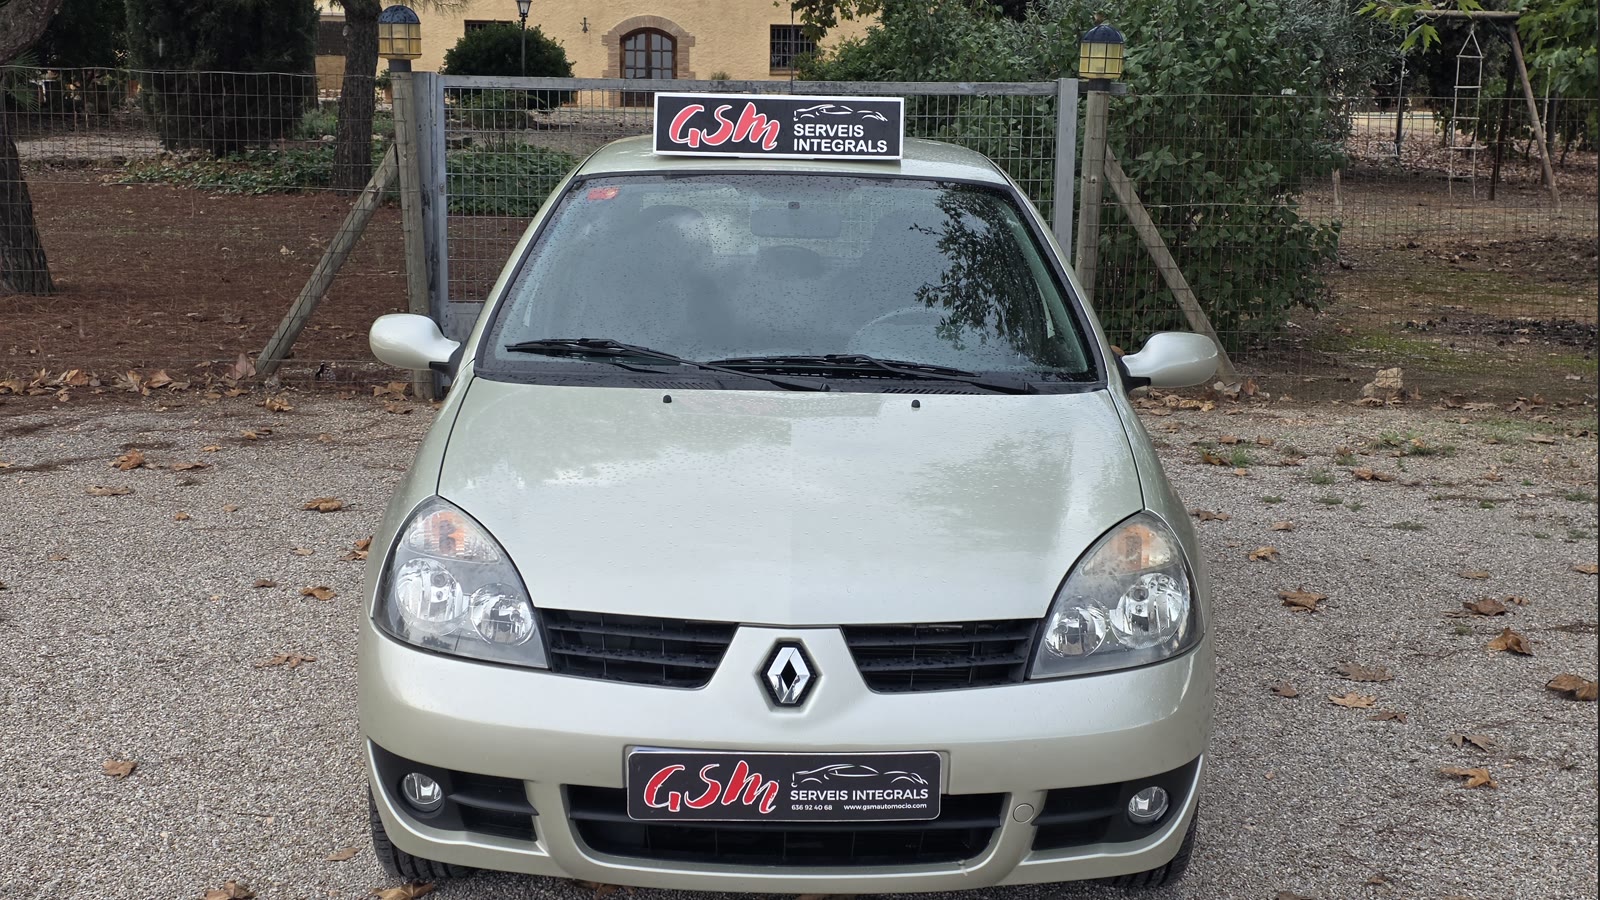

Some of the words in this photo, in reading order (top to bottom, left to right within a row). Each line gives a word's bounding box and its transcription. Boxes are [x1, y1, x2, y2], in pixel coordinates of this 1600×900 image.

[793, 123, 864, 137] SERVEIS
[793, 138, 888, 153] INTEGRALS
[790, 790, 848, 801] SERVEIS
[852, 788, 929, 801] INTEGRALS
